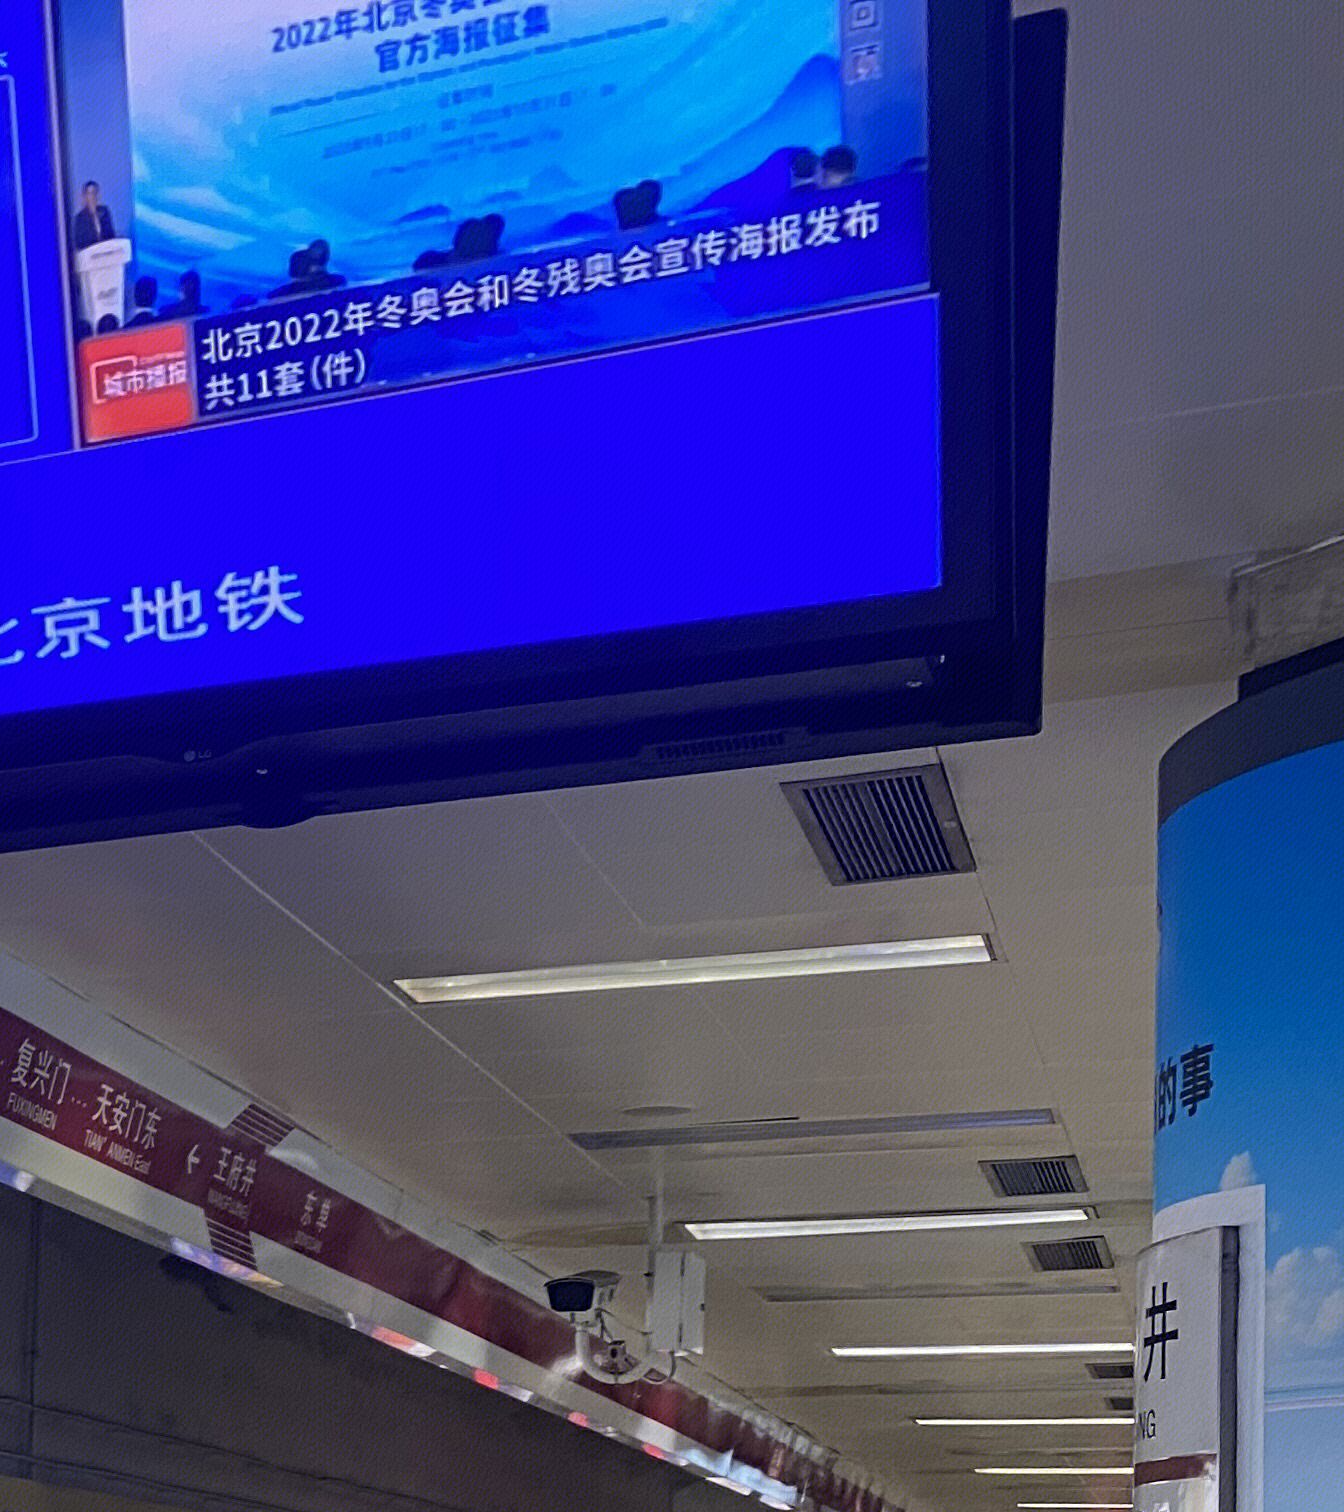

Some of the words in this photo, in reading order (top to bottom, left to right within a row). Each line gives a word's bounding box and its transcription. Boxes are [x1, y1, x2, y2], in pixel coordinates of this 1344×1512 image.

[374, 4, 550, 73] 官方海报征集
[201, 199, 882, 365] 北京2022年冬奥会和冬残奥会宣传海报发布
[204, 347, 366, 411] 共11套(件)
[11, 1037, 72, 1105] 复兴门
[1154, 1044, 1214, 1132] 的事
[7, 1091, 59, 1131] FUXINGMEN
[91, 1083, 162, 1151] 天安门东
[213, 1146, 257, 1197] 王府井
[1143, 1281, 1180, 1383] 井
